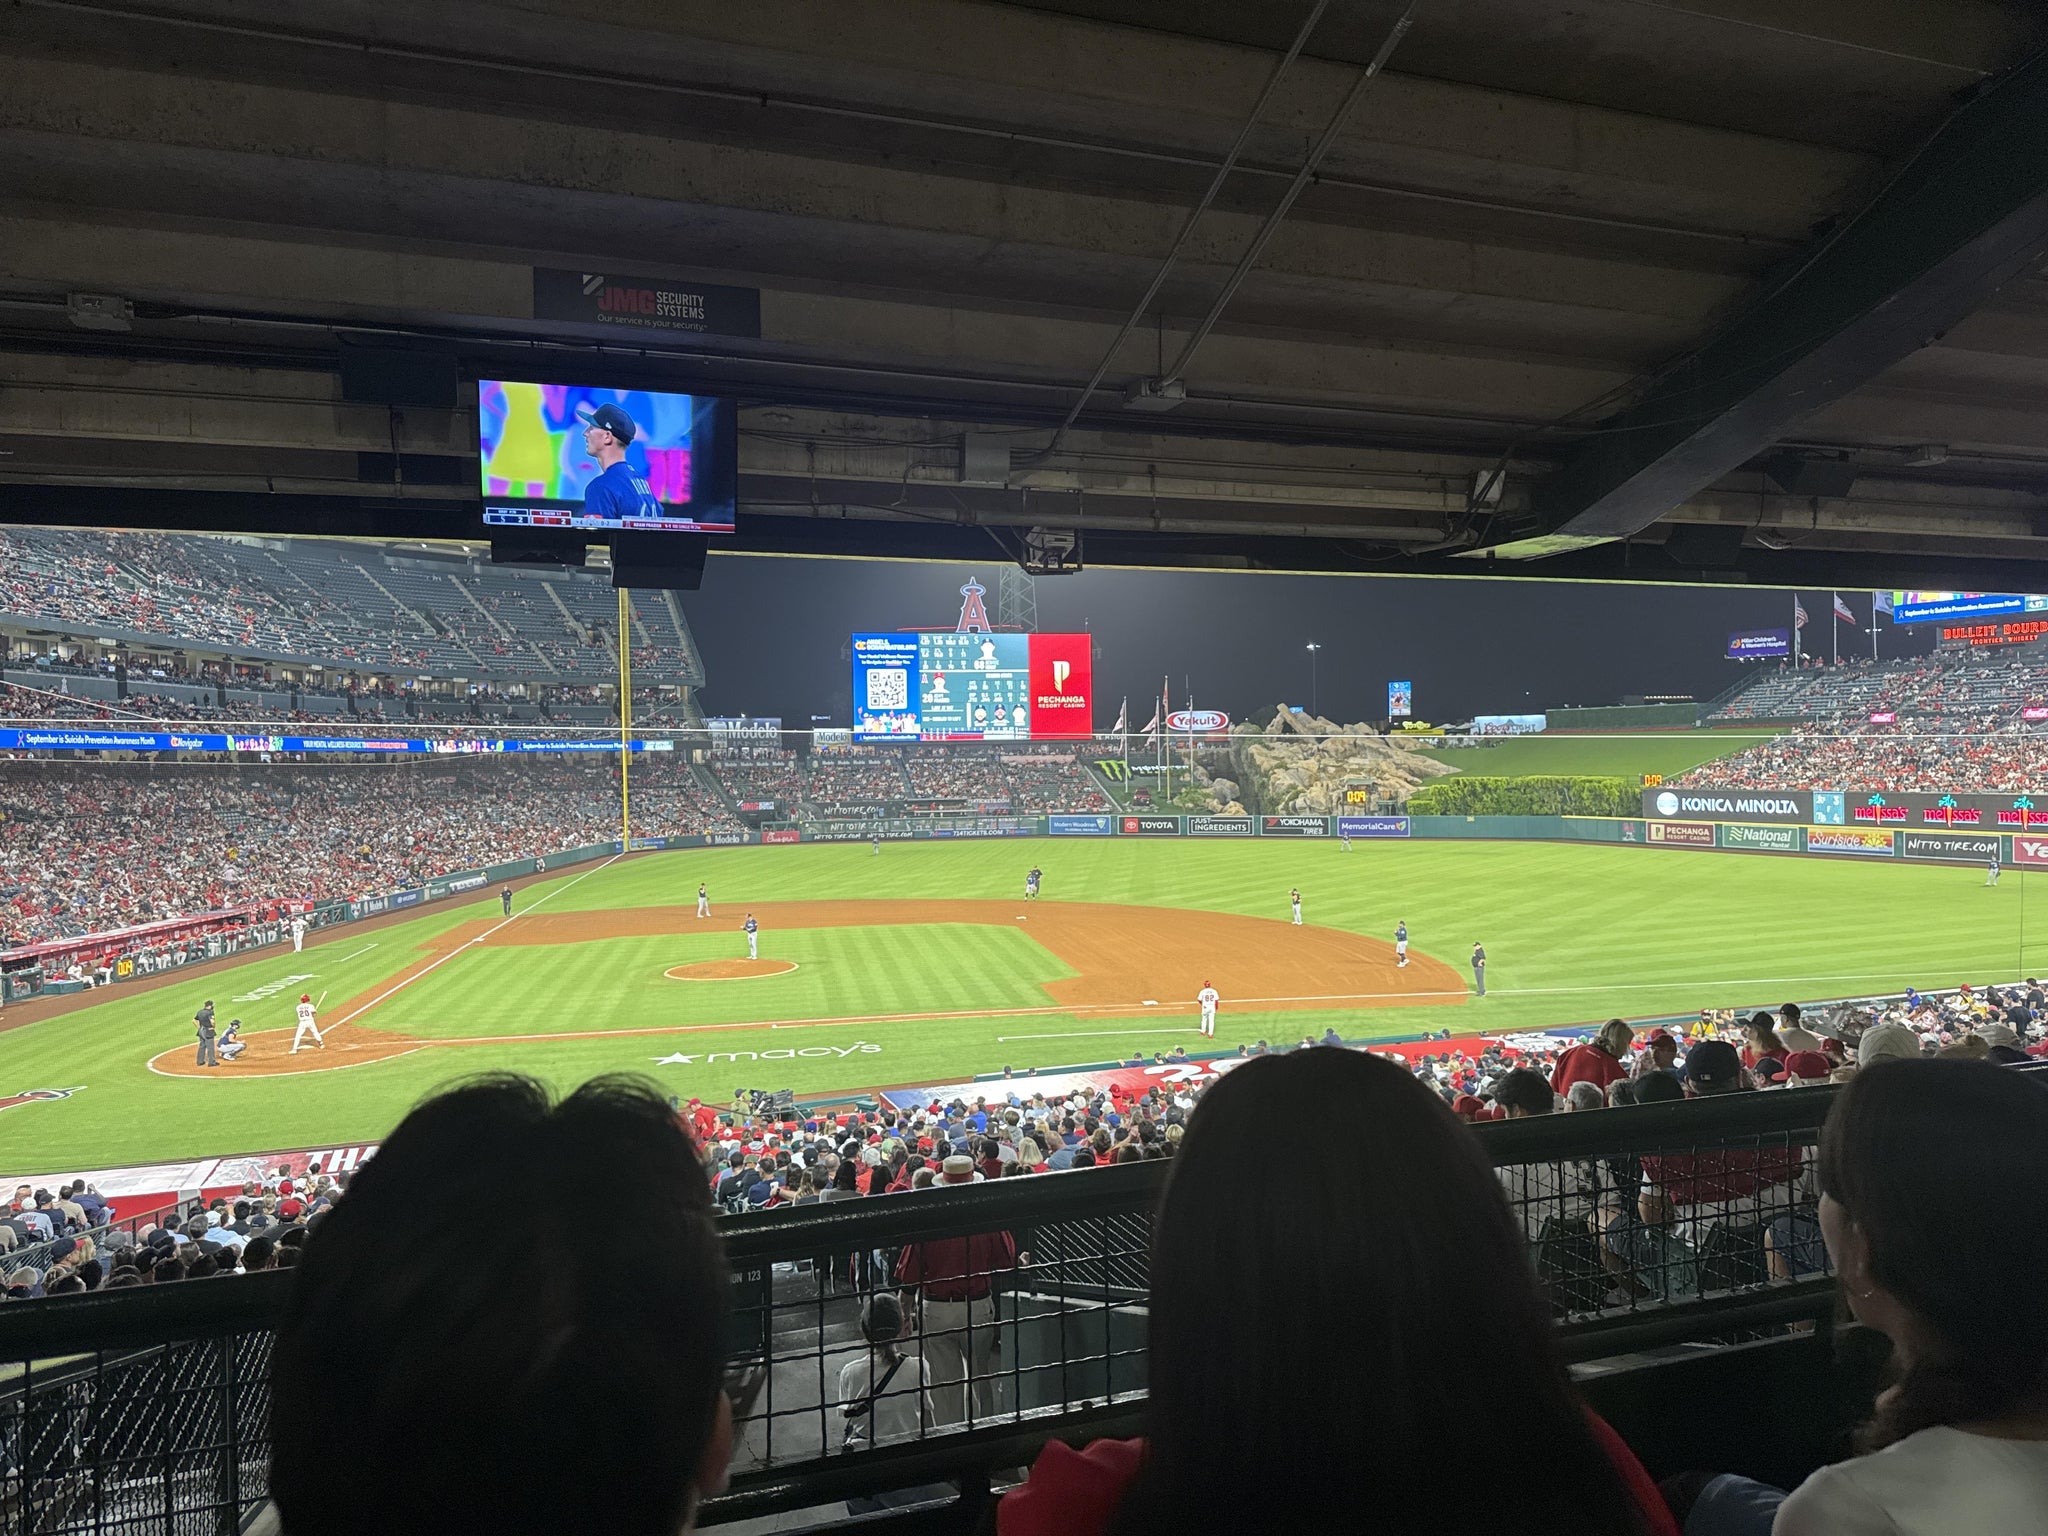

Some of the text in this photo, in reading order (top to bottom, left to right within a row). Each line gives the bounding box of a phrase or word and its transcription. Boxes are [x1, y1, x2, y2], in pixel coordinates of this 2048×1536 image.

[598, 288, 656, 314] JMG
[656, 291, 704, 307] SECURITY
[656, 304, 705, 320] SYSTEMS
[598, 314, 613, 323] Our
[616, 316, 643, 326] service
[645, 318, 651, 326] is
[653, 321, 670, 329] your
[1943, 625, 1997, 640] BULLEIT
[1970, 638, 2003, 646] FRONTIER
[1177, 716, 1219, 725] Yakult
[728, 722, 777, 739] Modelo
[817, 732, 847, 742] Modelo
[26, 734, 155, 745] September is Suicide Prevention Awareness Month
[1644, 775, 1662, 787] 0:09
[1347, 791, 1366, 803] 0:09
[1682, 797, 1734, 813] KONICA
[1736, 799, 1799, 815] MINOLTA
[1855, 806, 1906, 820] melissa's
[1924, 807, 1980, 822] melissa's
[1141, 821, 1173, 829] TOYOTA
[1341, 822, 1395, 830] MemorialCare
[1667, 827, 1709, 835] PECHANGA
[715, 834, 739, 844] Modelo
[1744, 827, 1792, 842] National
[1812, 832, 1861, 847] Surfside
[1908, 838, 1998, 855] NITTO TIRE.COM
[299, 1010, 309, 1018] 20
[707, 1041, 882, 1063] macy's
[748, 1270, 761, 1282] 123
